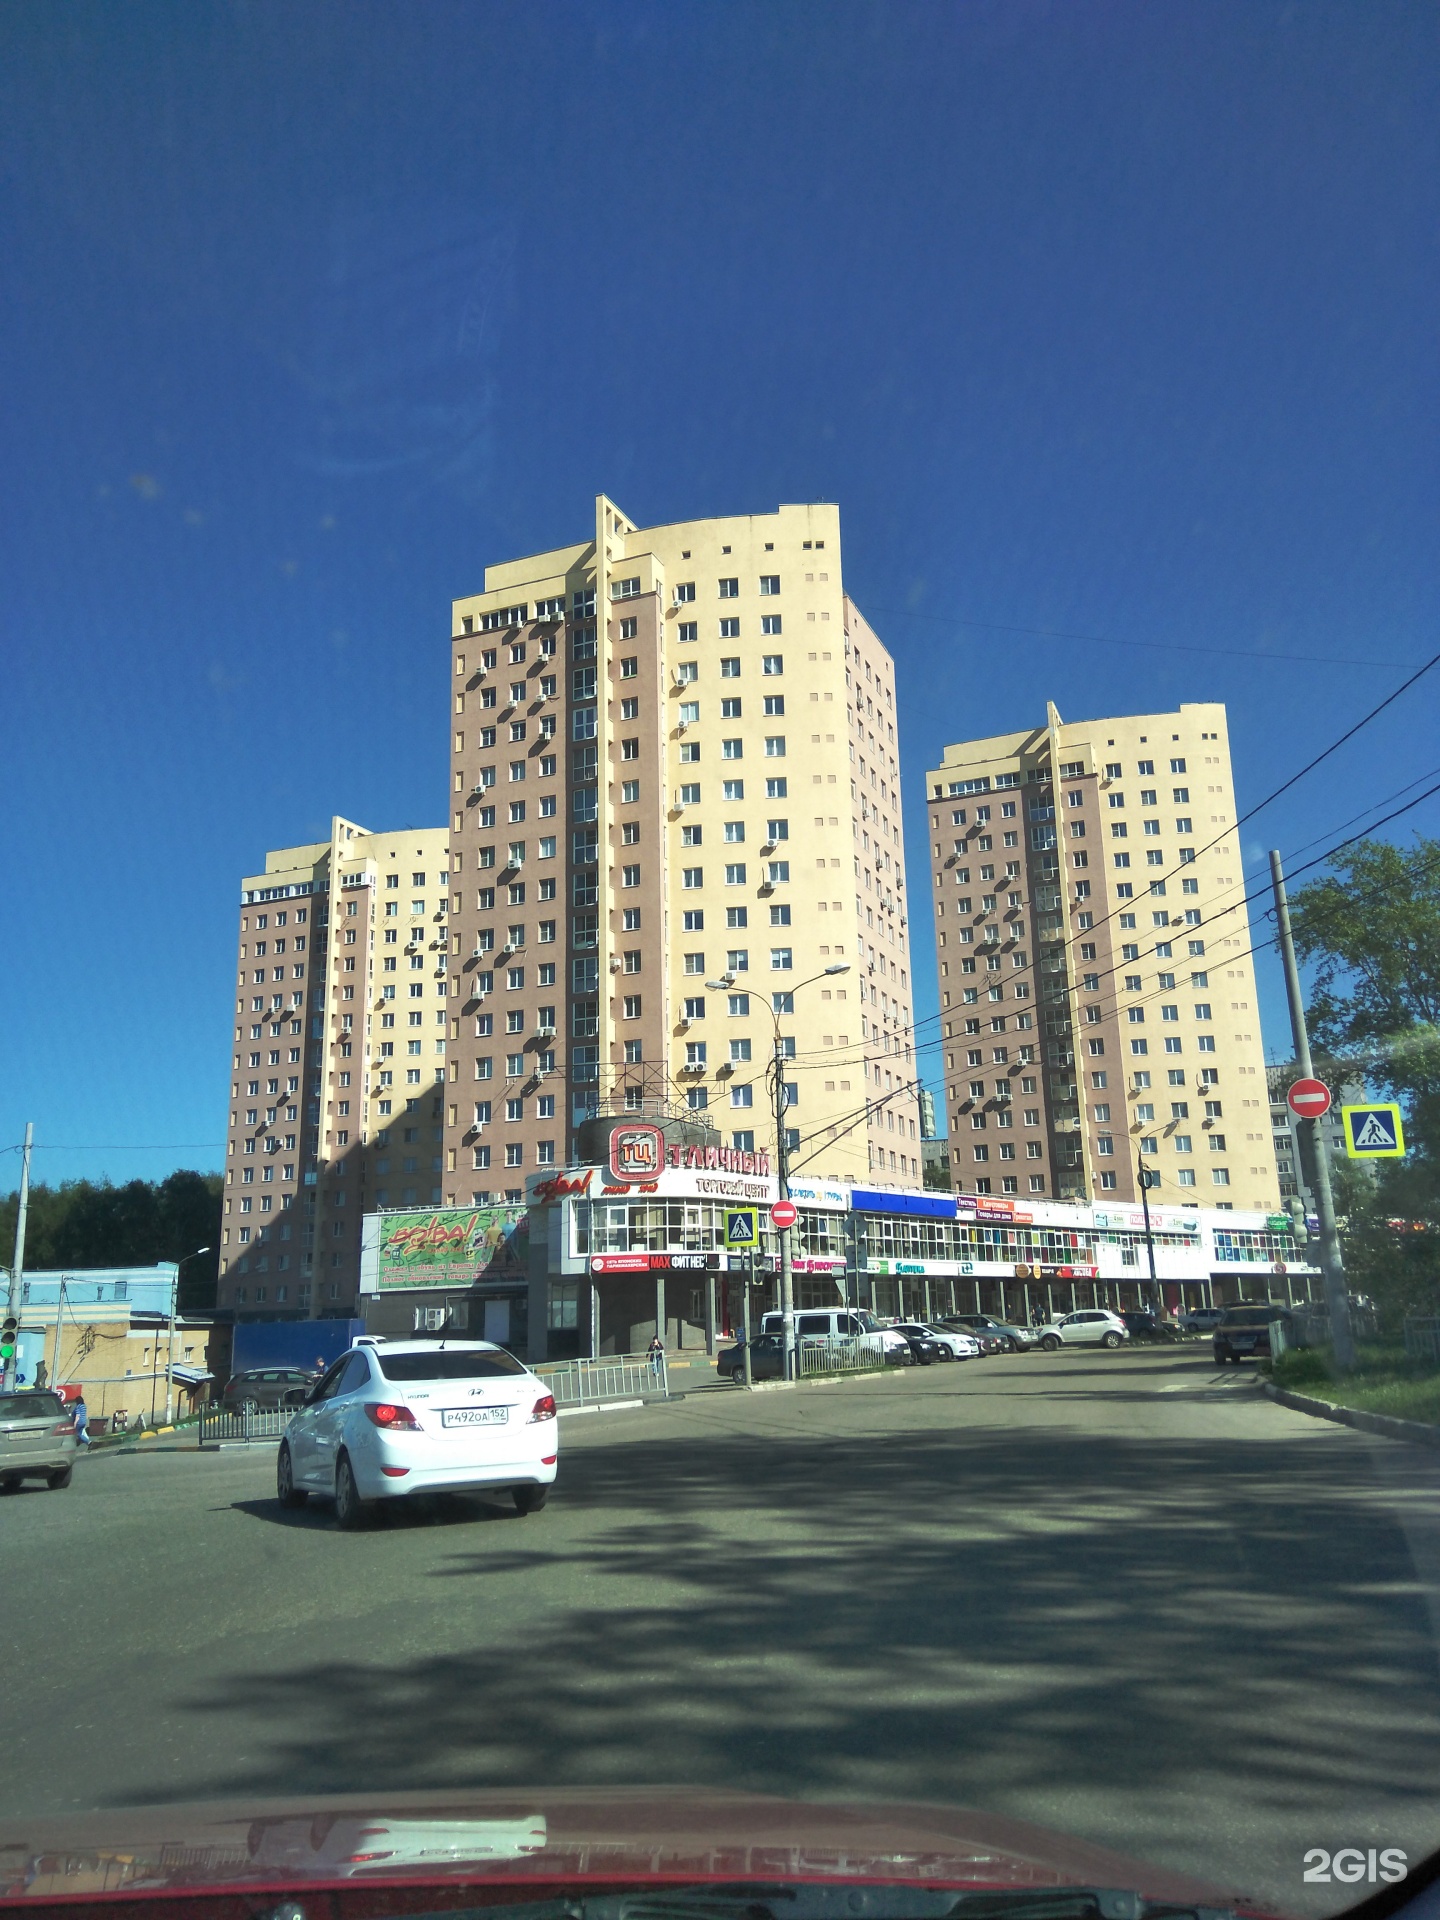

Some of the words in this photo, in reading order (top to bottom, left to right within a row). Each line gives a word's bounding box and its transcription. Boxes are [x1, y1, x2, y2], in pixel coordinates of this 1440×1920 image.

[622, 1144, 652, 1164] ТЦ
[696, 1178, 744, 1196] ТОРГОВЫЙ
[744, 1183, 770, 1199] ЦЕНТР
